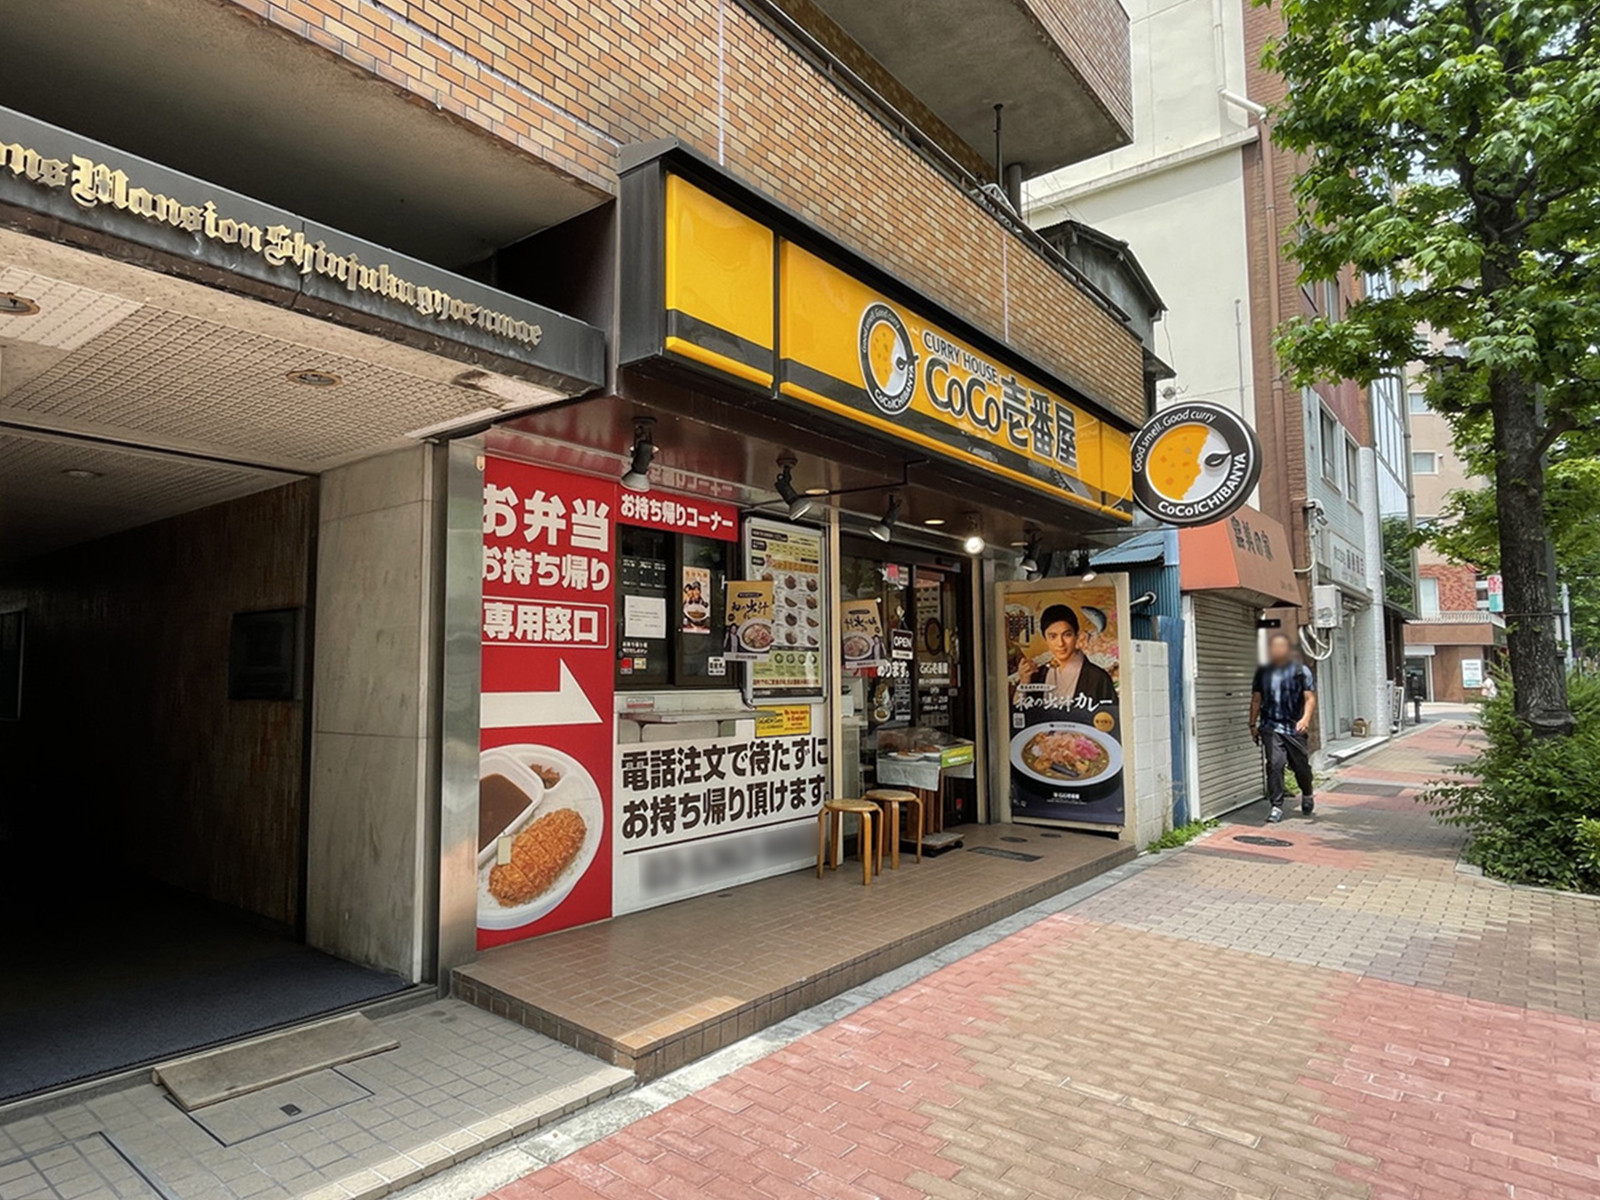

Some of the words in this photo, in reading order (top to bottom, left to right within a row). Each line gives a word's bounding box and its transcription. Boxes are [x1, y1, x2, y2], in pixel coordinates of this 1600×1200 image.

[71, 154, 263, 252] Mansion
[923, 330, 961, 365] CURRY
[963, 352, 998, 385] HOUSE
[1132, 447, 1146, 473] Good
[1162, 408, 1190, 426] Good
[1190, 410, 1217, 424] curry
[1157, 452, 1247, 517] CoCoICHIBANYA
[483, 483, 611, 553] お弁当
[620, 493, 734, 532] お持ち帰りコーナー
[482, 545, 611, 592] お持ち帰り
[483, 602, 599, 643] 専用窓口
[893, 636, 912, 648] OPEN
[621, 737, 829, 791] 電話注文で待たずに
